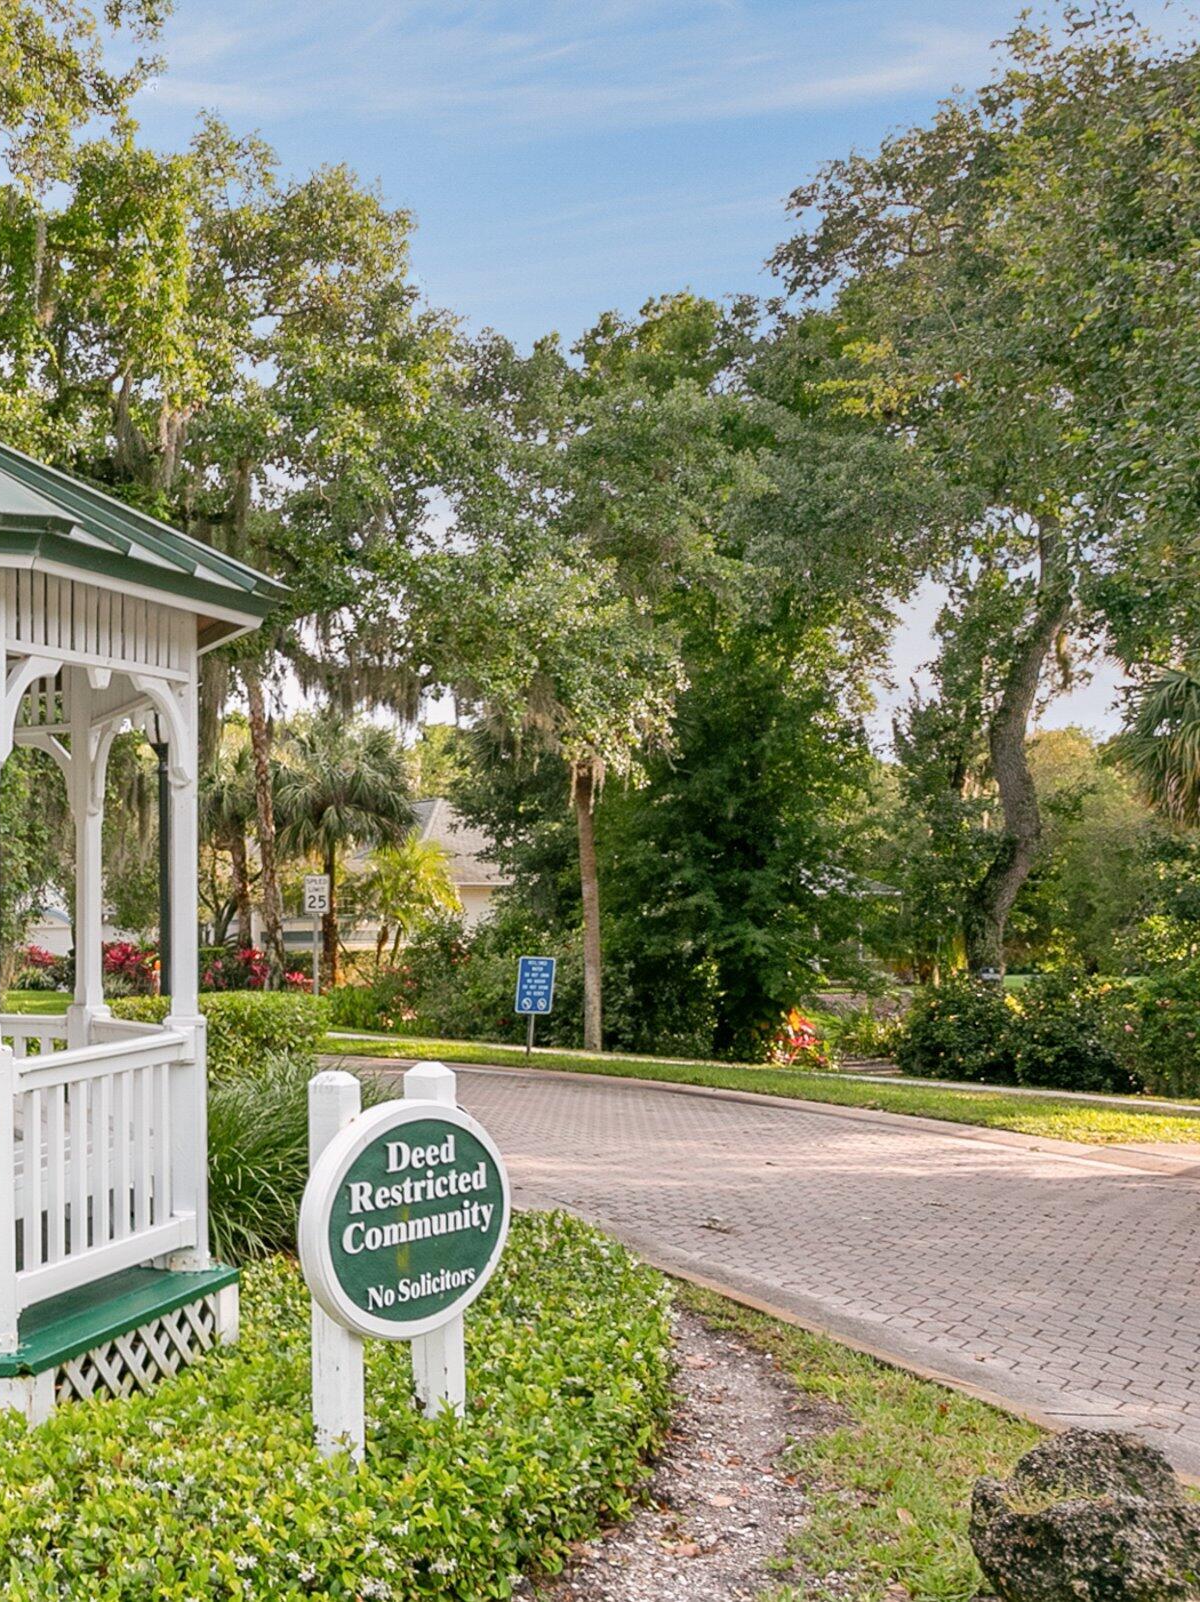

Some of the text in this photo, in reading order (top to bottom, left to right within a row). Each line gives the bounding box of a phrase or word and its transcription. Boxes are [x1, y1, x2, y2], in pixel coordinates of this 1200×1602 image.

[308, 895, 327, 909] 25
[386, 1134, 456, 1174] Deed
[348, 1161, 488, 1215] Restricted
[341, 1199, 494, 1255] Community
[367, 1267, 476, 1311] No Solicitors
